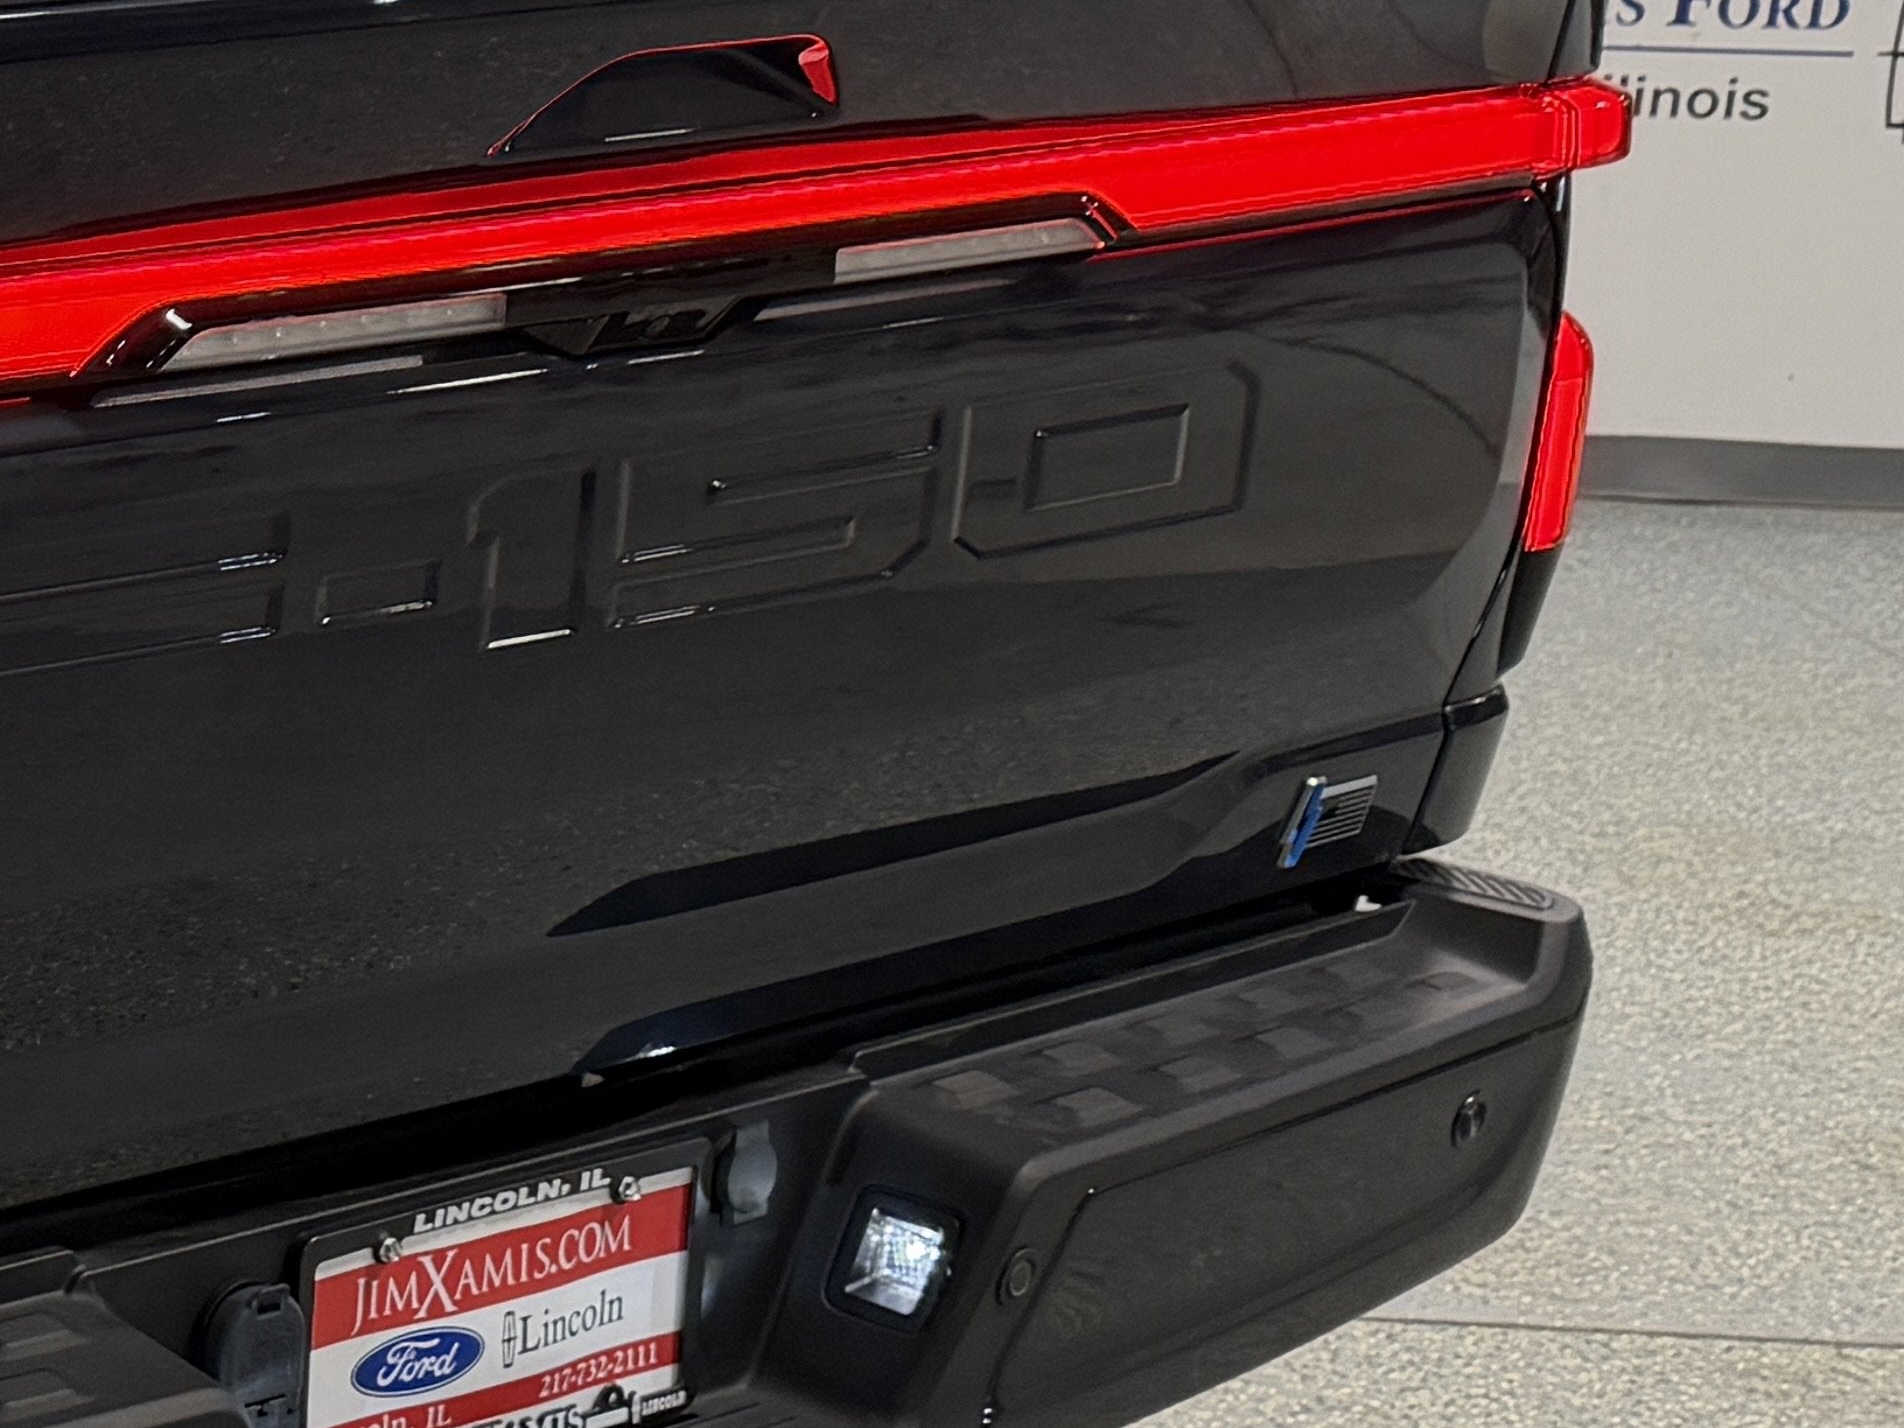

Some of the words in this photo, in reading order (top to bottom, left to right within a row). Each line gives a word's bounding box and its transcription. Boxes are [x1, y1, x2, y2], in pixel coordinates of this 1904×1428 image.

[1603, 73, 1769, 121] inois
[413, 1178, 571, 1234] LINCOLN,
[580, 1168, 612, 1191] IL
[352, 1215, 633, 1335] JIMXAMIS.COM
[518, 1289, 624, 1355] Lincoln
[377, 1338, 456, 1387] Ford
[539, 1342, 659, 1398] 217-732-2111
[426, 1405, 452, 1428] IL
